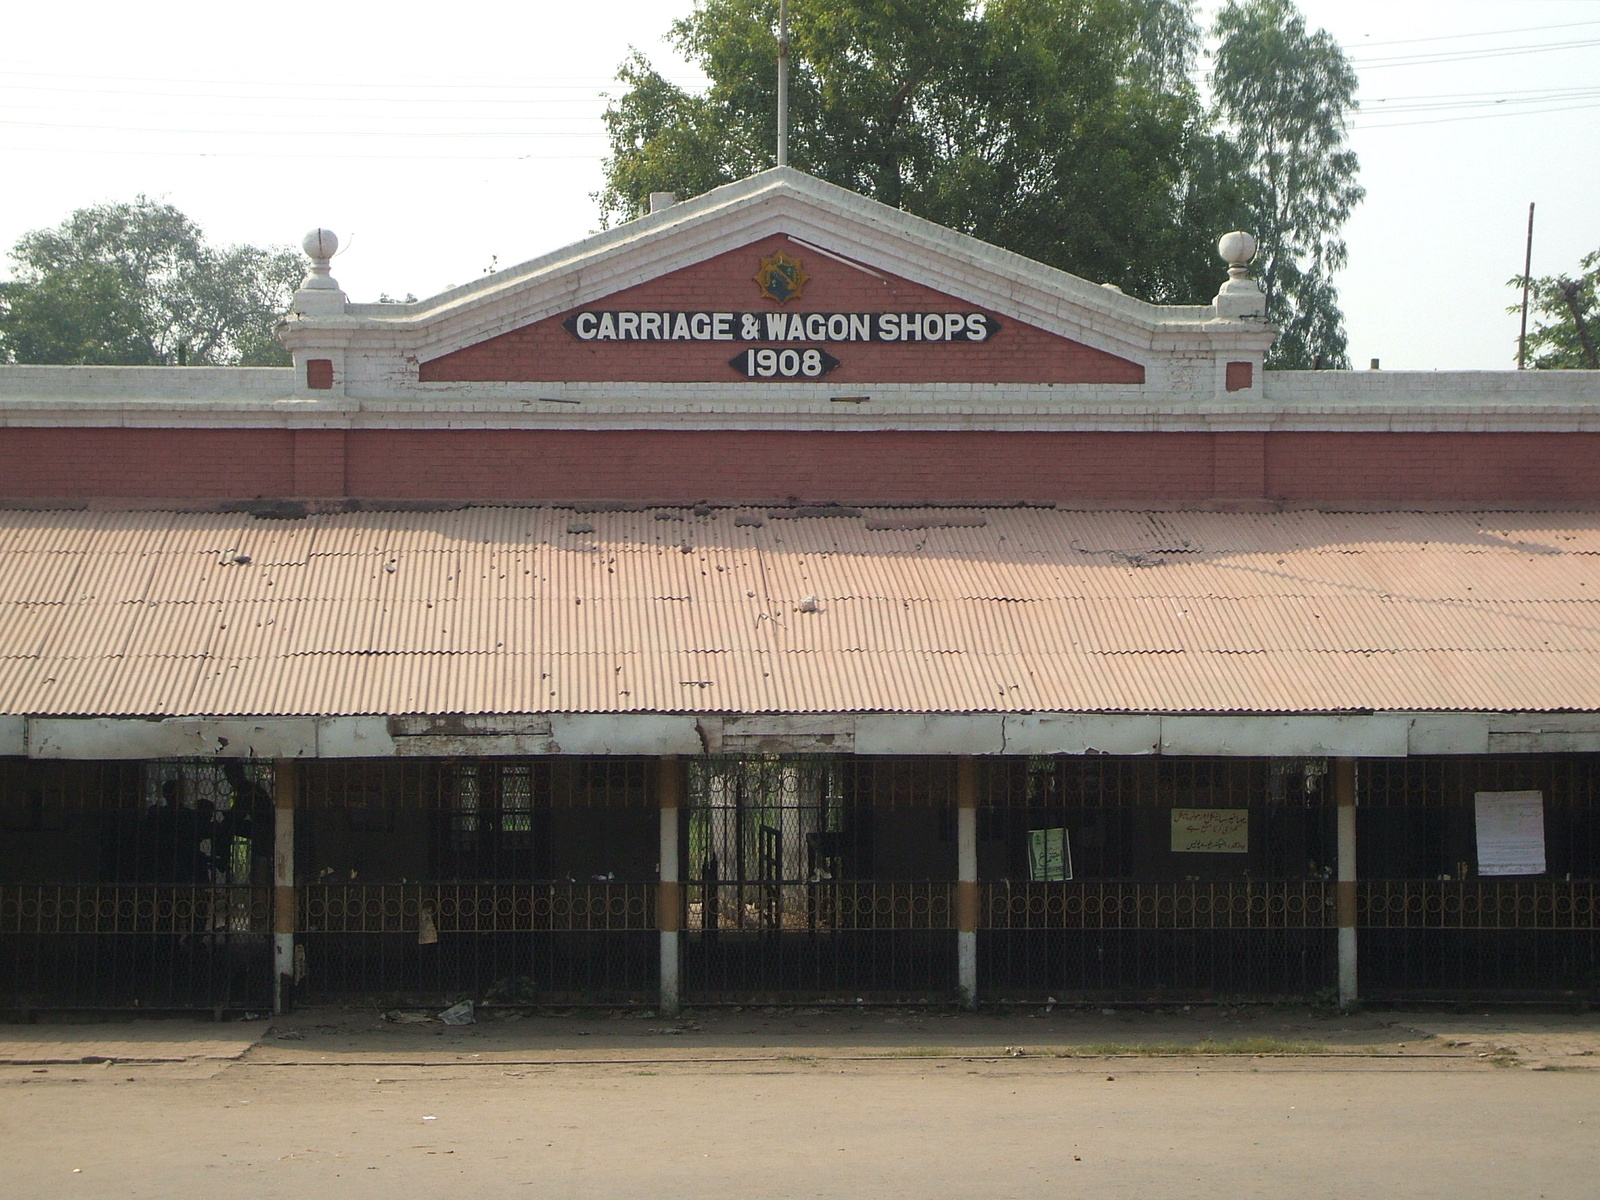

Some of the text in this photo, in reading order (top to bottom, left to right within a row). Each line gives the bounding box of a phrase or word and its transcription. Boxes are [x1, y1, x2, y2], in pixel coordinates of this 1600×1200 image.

[576, 312, 988, 341] CARRIAGE & WAGON SHOPS
[747, 348, 822, 377] 1908
